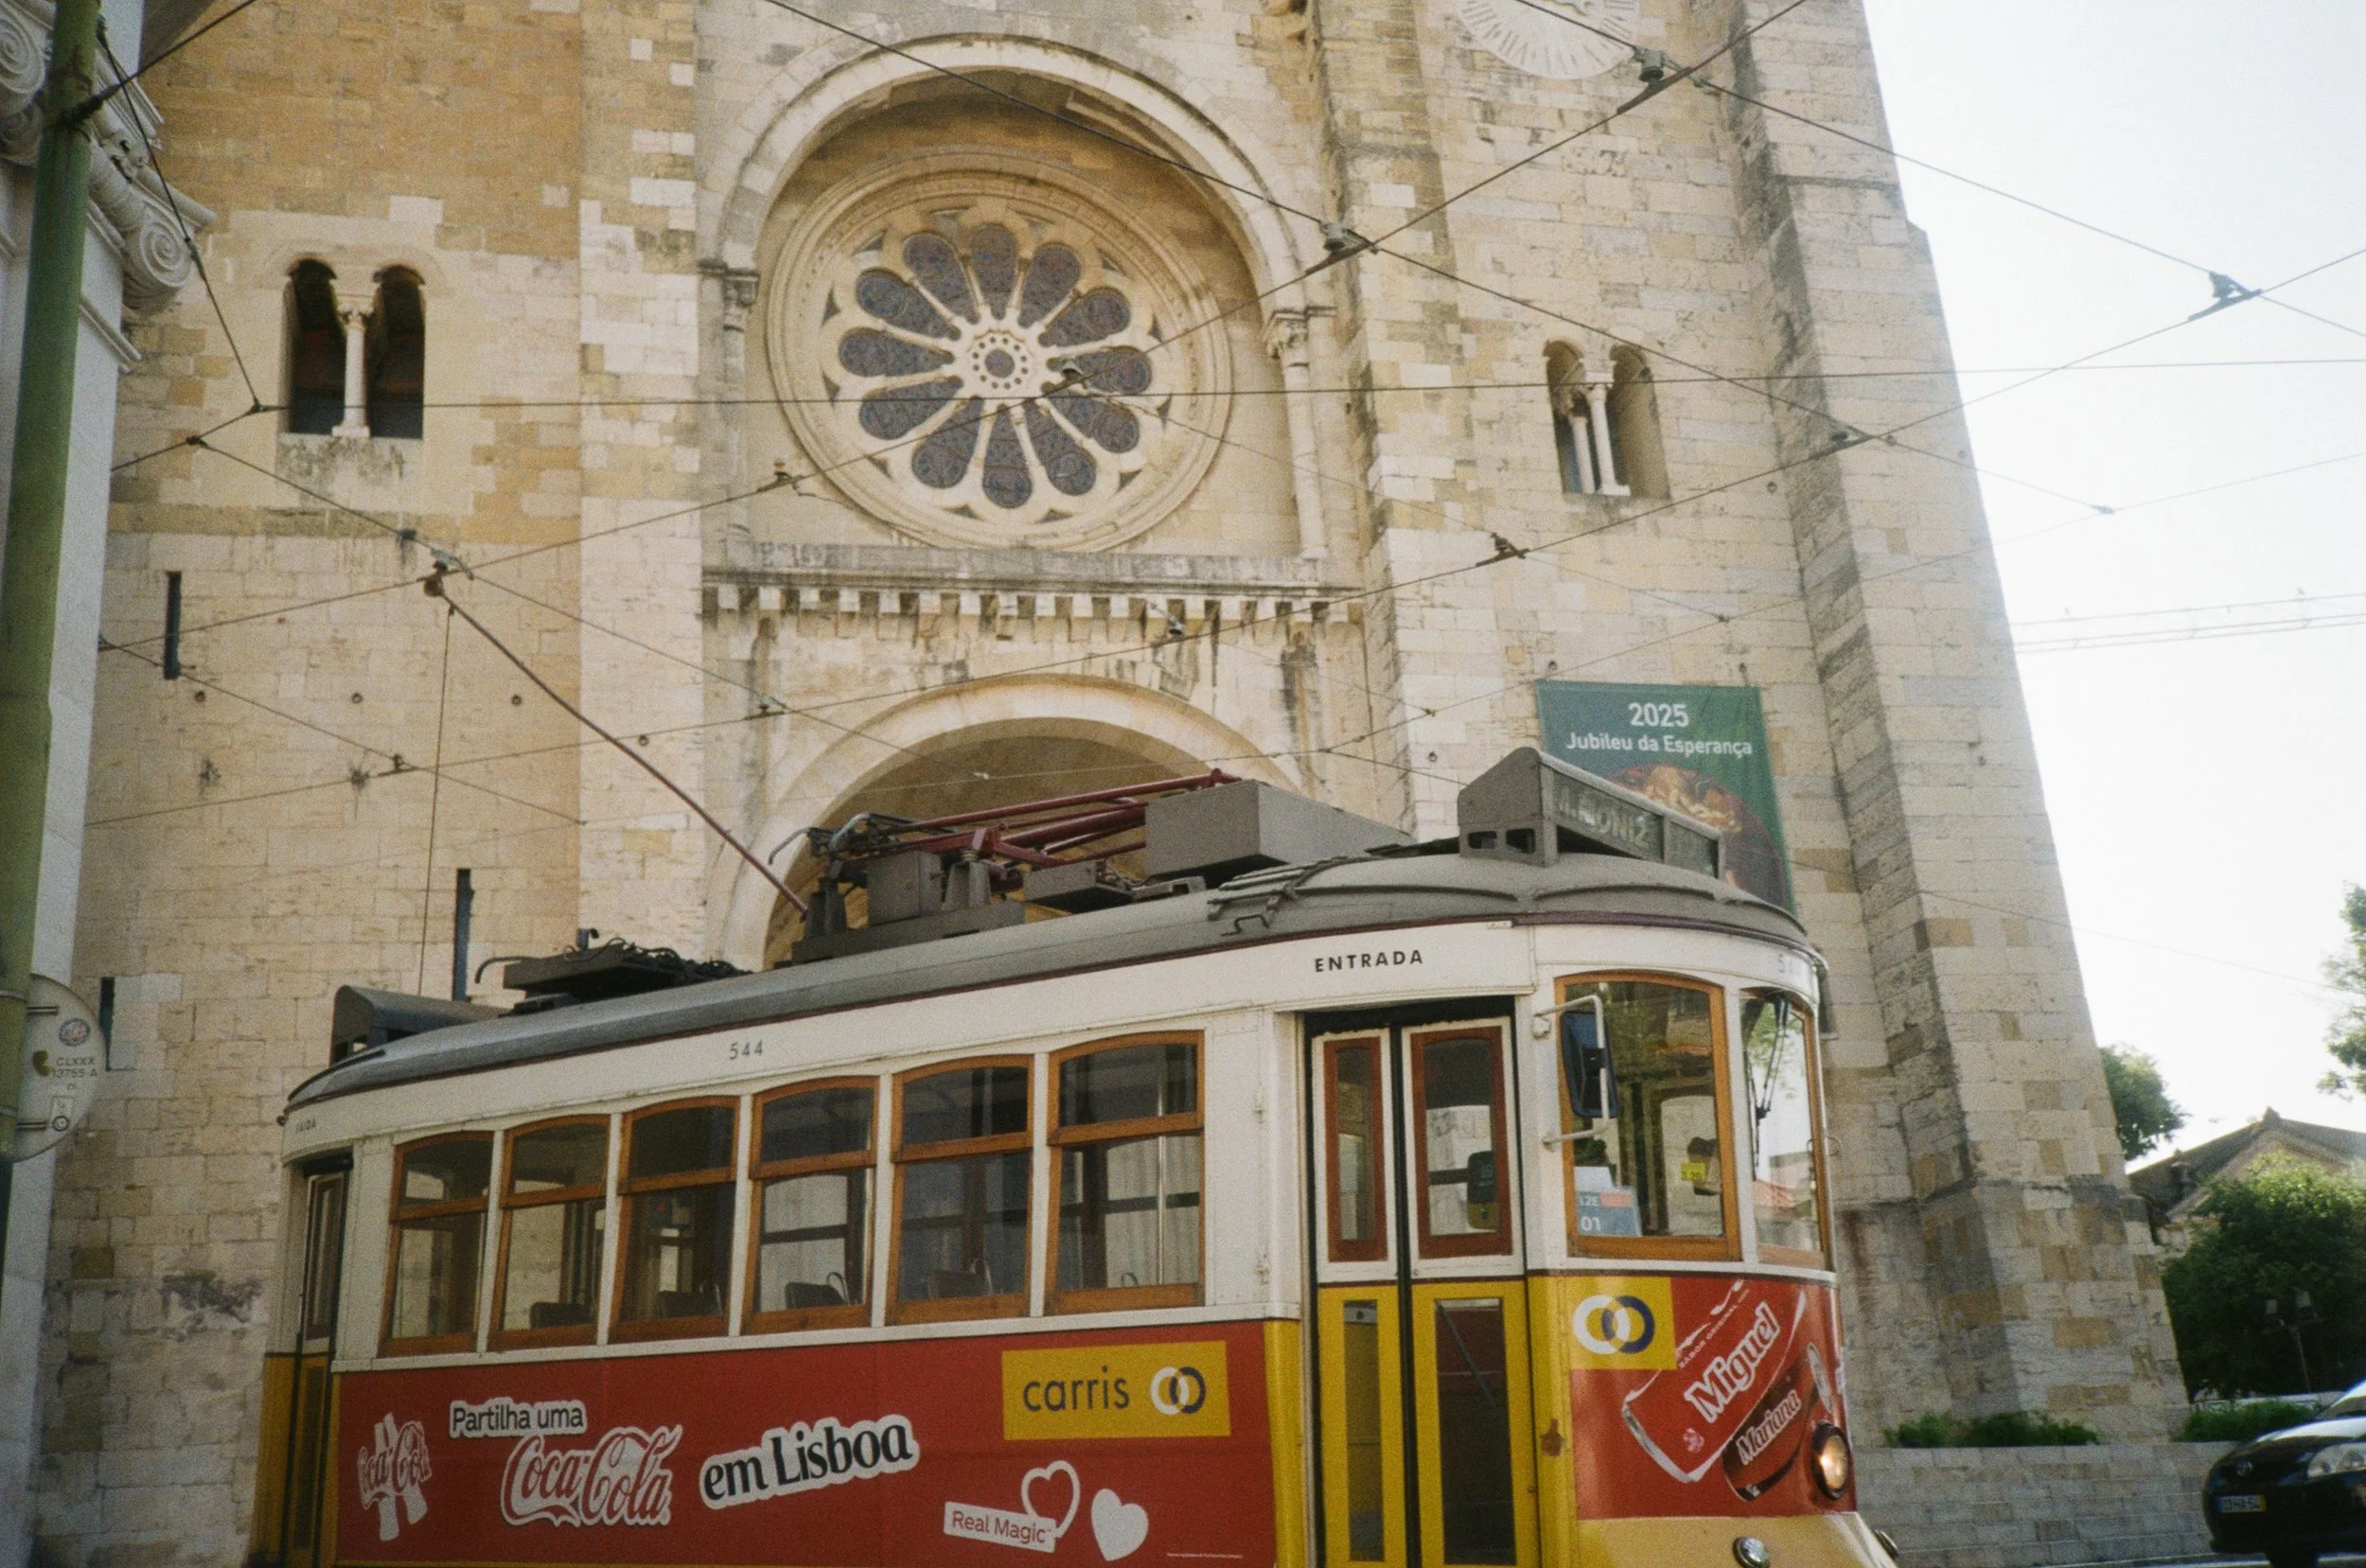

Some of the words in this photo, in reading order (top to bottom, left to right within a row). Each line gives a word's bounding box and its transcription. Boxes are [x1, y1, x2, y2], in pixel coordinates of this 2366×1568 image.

[1629, 702, 1689, 727] 2025
[1566, 732, 1633, 750] Jubileu
[1638, 733, 1658, 751] da
[1664, 735, 1752, 758] Esperança
[1315, 949, 1422, 973] ENTRADA
[729, 1039, 763, 1060] 544
[1581, 1216, 1600, 1231] 01
[1684, 1301, 1780, 1422] Miguel
[1023, 1365, 1130, 1411] carris
[453, 1405, 530, 1432] Partilha
[537, 1407, 584, 1428] uma
[1736, 1389, 1802, 1466] Mariana
[502, 1425, 681, 1525] Coca-Cola
[703, 1458, 767, 1501] em
[772, 1422, 912, 1485] Lisboa
[952, 1511, 990, 1533] Real
[994, 1519, 1047, 1545] Magic
